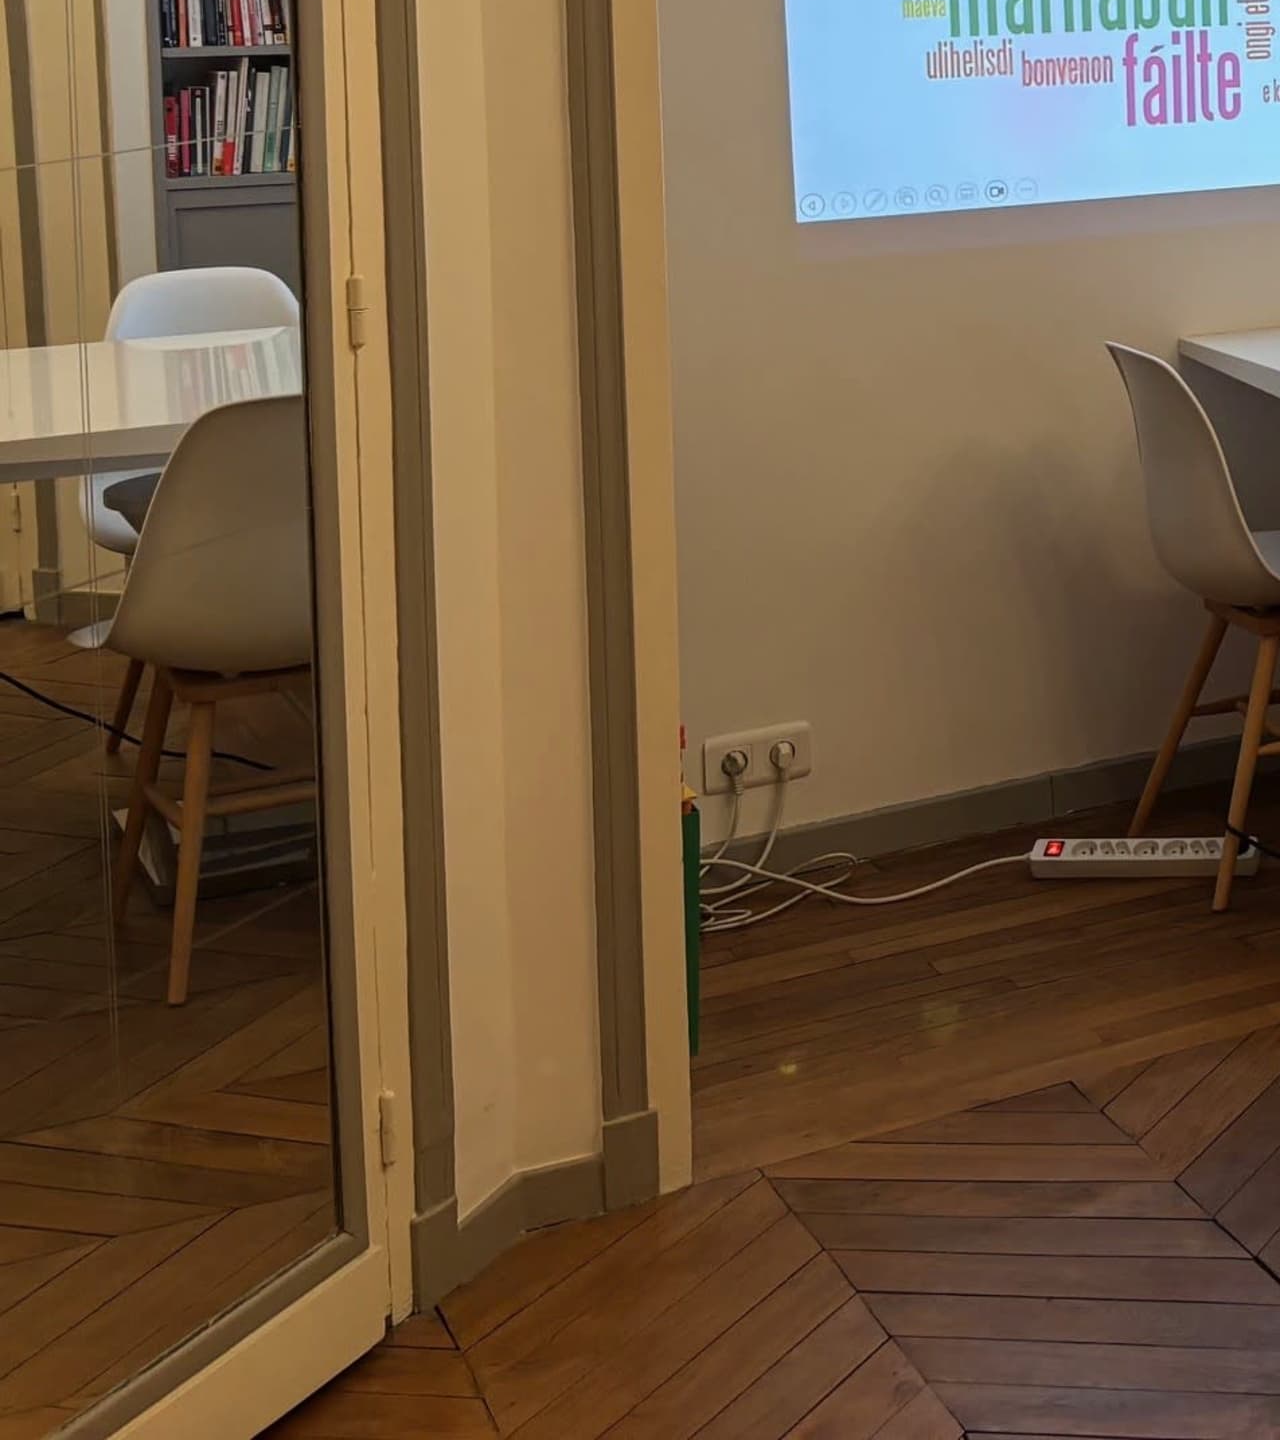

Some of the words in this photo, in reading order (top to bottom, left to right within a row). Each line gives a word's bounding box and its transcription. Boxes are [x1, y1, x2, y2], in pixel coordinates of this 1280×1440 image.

[926, 38, 1014, 79] ulihelisdi
[1237, 21, 1275, 60] ongi
[1022, 50, 1114, 88] bonvenon
[1122, 30, 1242, 128] fáilte
